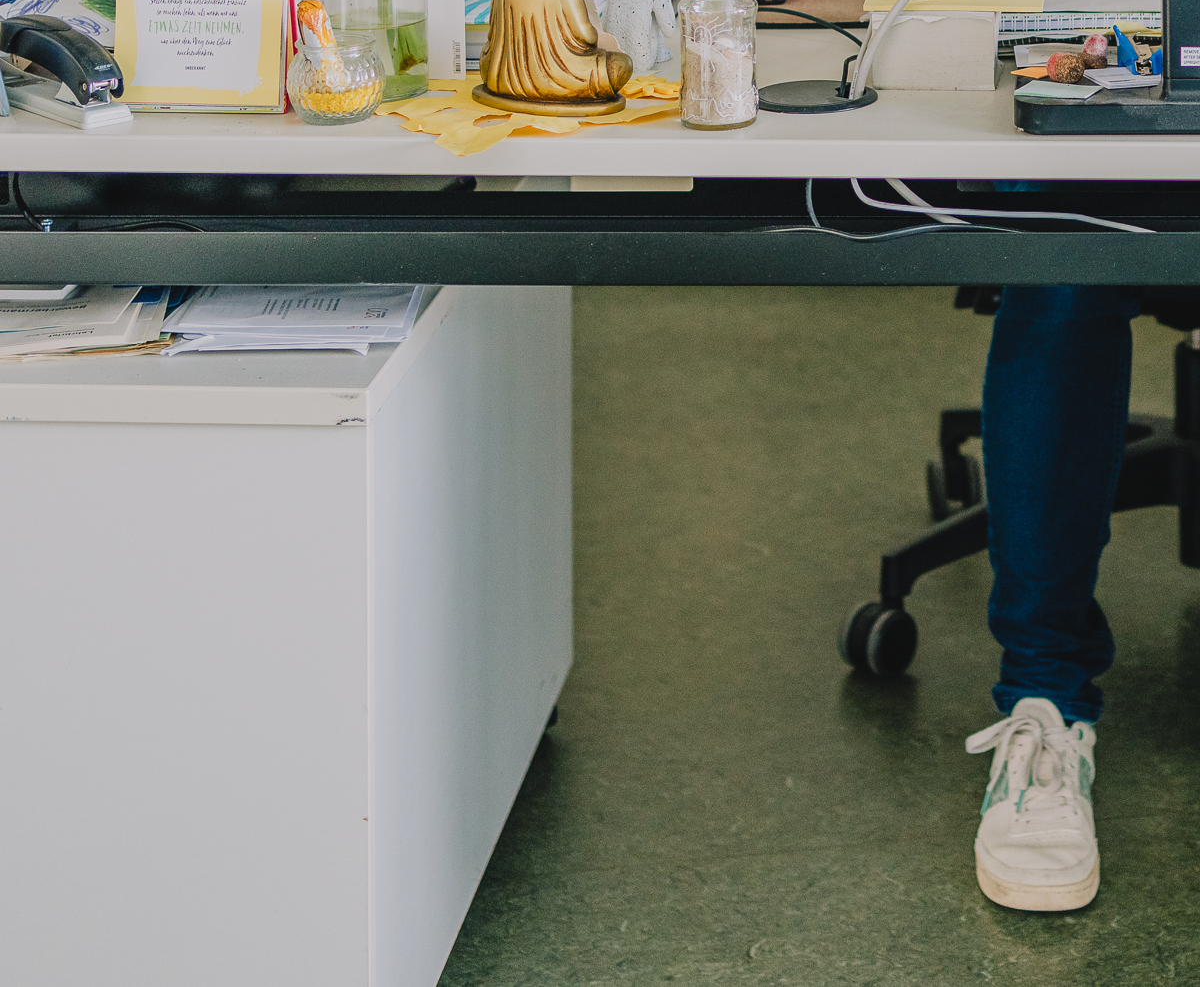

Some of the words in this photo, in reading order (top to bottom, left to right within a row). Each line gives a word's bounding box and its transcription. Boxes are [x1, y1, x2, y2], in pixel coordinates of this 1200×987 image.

[148, 19, 179, 34] ETWAS
[182, 20, 202, 34] ZEIT
[192, 37, 205, 49] Weg
